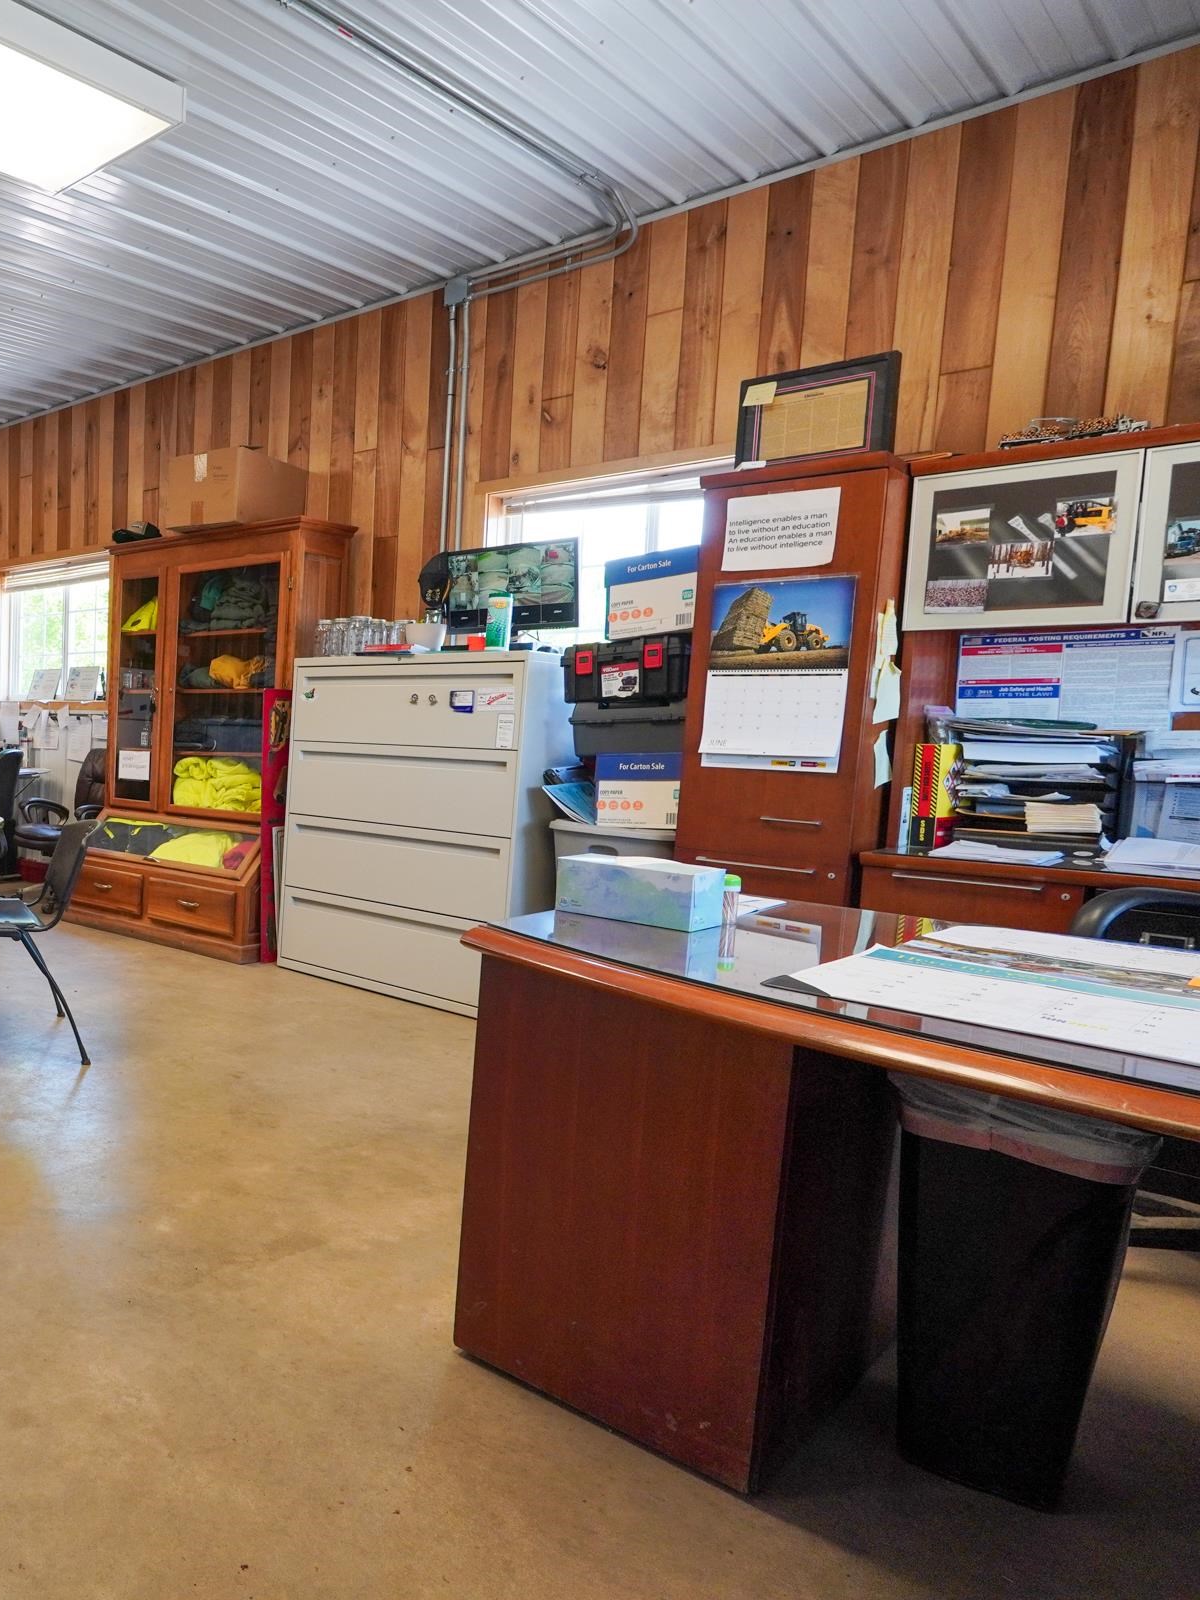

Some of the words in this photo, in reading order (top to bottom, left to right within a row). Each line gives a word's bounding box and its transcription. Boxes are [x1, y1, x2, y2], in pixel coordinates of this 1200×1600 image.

[729, 517, 770, 527] Intelligence
[772, 514, 802, 523] enables
[737, 527, 749, 535] live
[752, 525, 779, 534] without
[792, 521, 831, 530] education
[739, 535, 776, 543] education
[777, 532, 807, 540] enables
[750, 542, 778, 551] without
[779, 539, 823, 549] intelligence
[627, 566, 637, 574] For
[637, 563, 658, 572] Carton
[658, 559, 672, 568] Sale
[1028, 634, 1062, 642] POSTING
[1062, 632, 1126, 641] REQUIREMENTS
[651, 762, 665, 770] Sale
